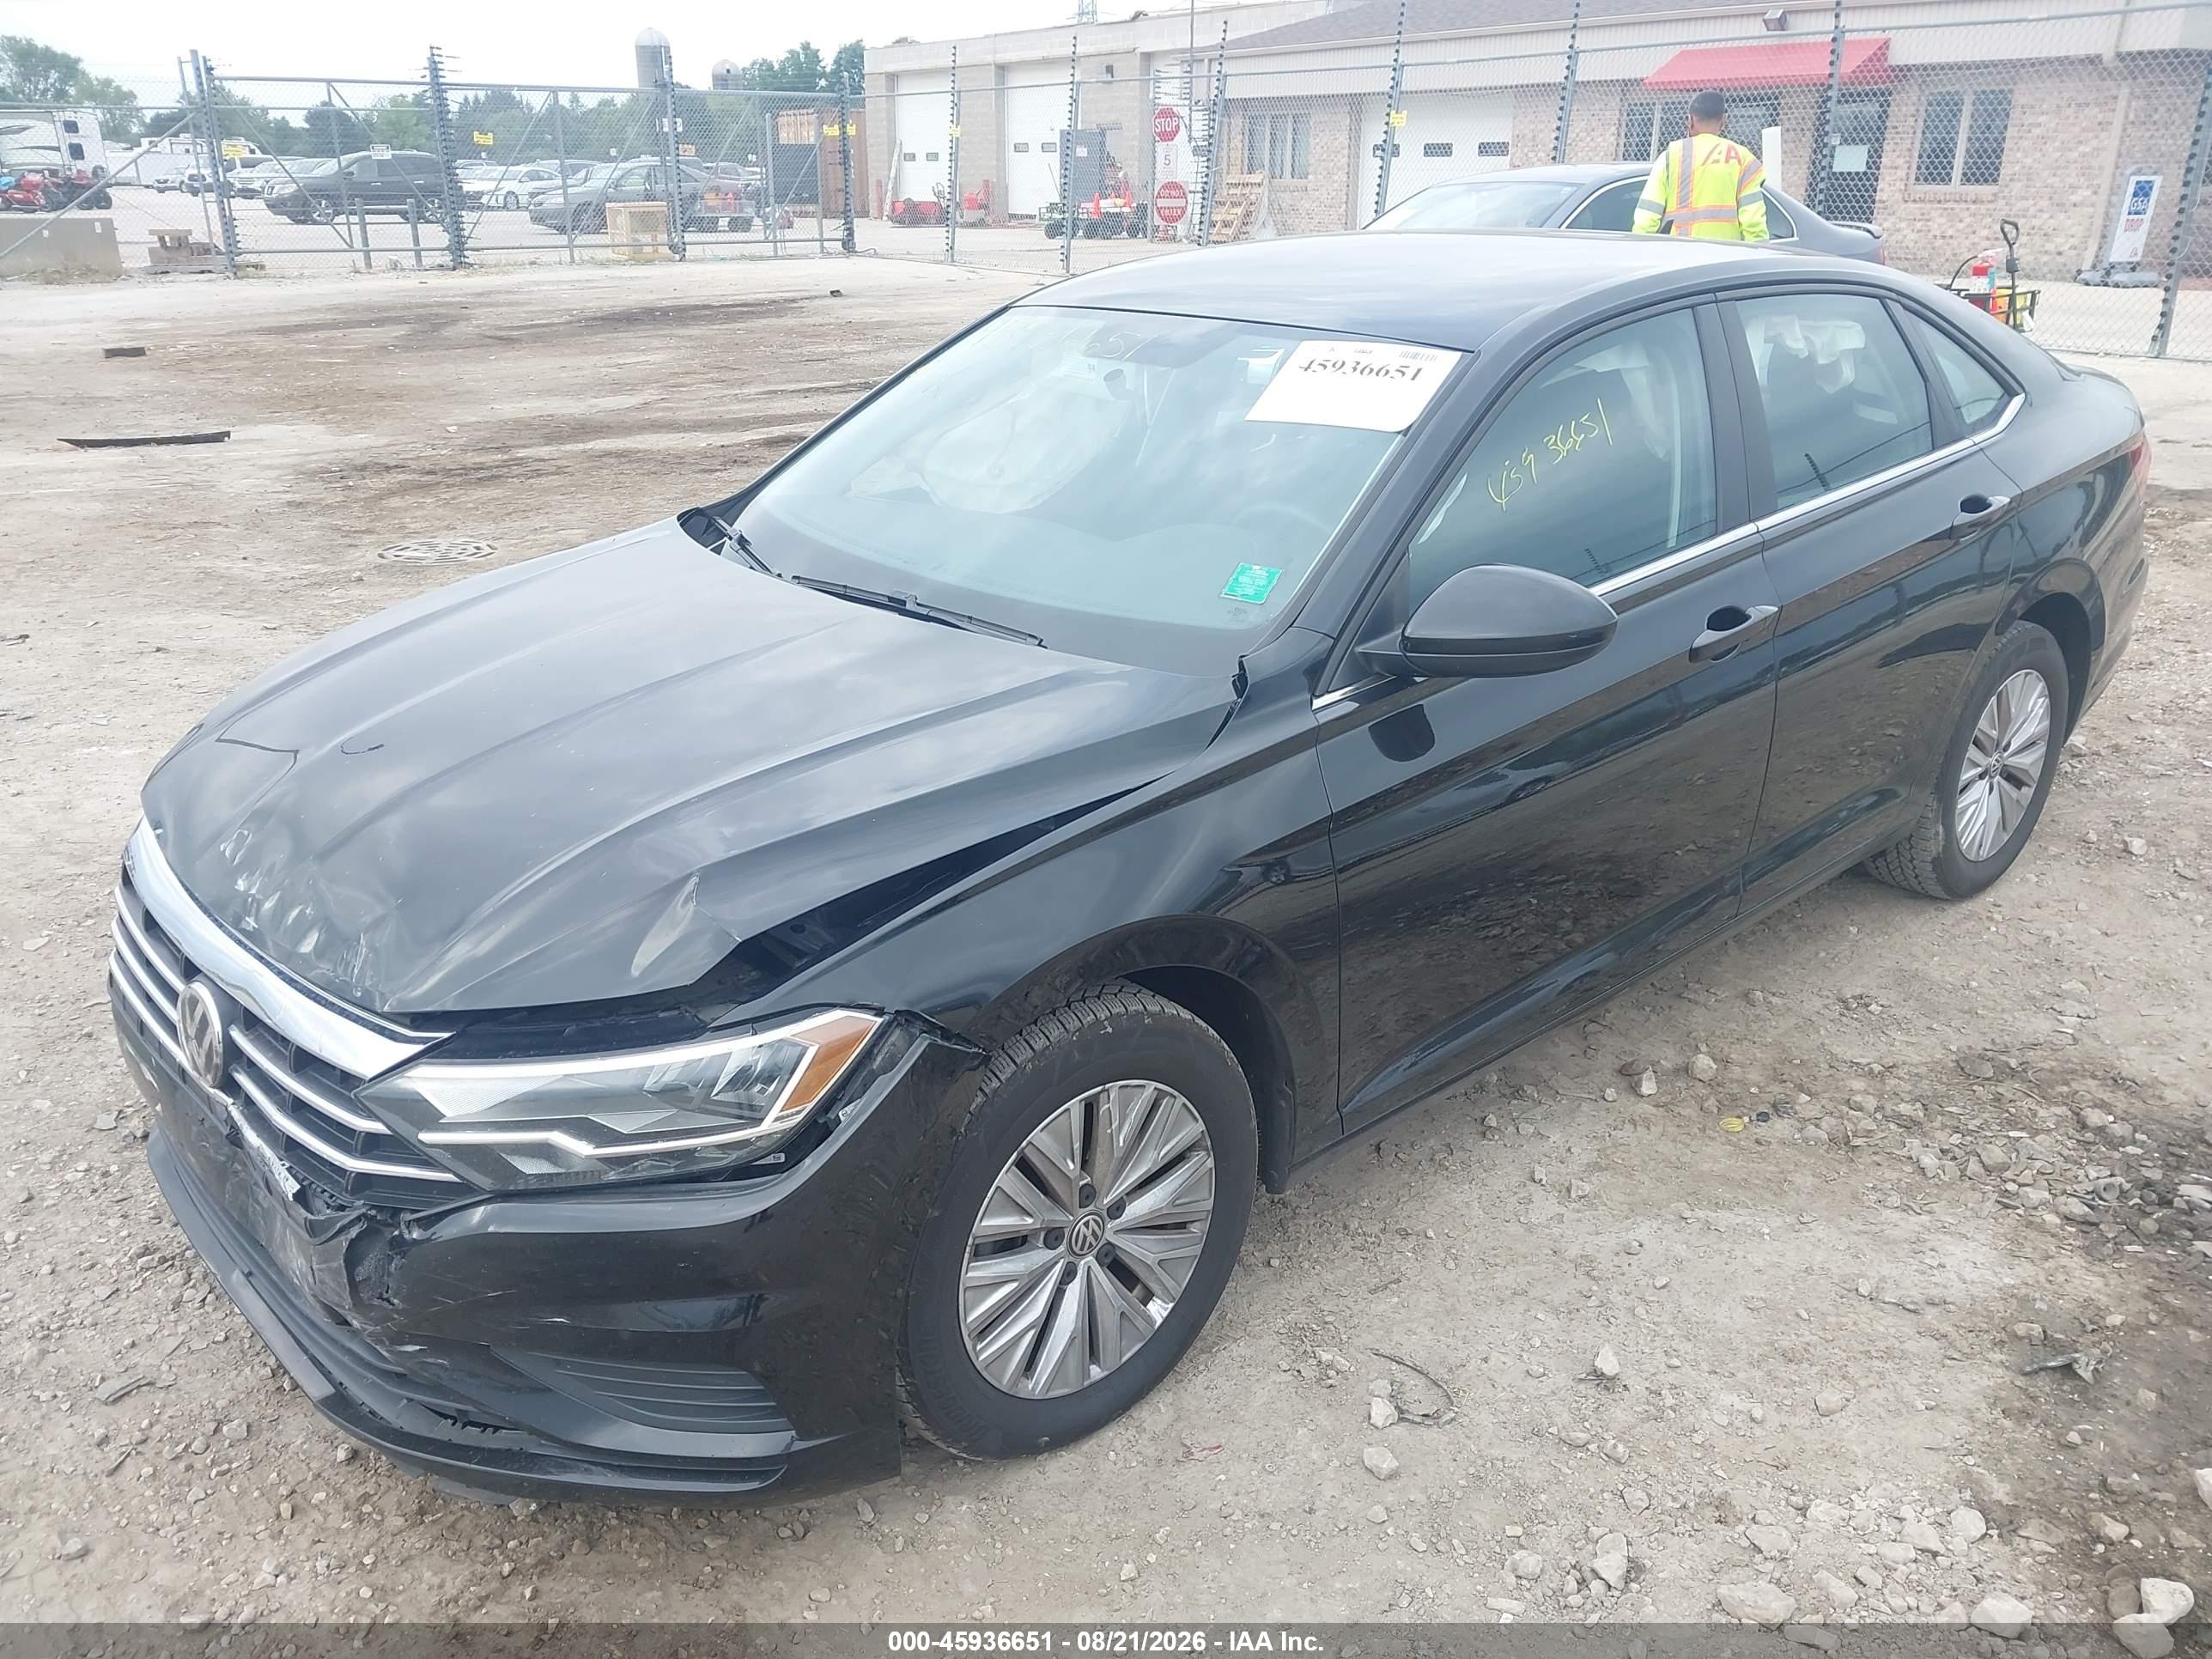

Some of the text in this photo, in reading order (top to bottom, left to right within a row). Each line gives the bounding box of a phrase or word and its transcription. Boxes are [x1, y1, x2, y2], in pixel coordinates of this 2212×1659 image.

[1155, 117, 1178, 132] STOP
[1164, 154, 1171, 166] 5
[1297, 357, 1424, 381] 45936651
